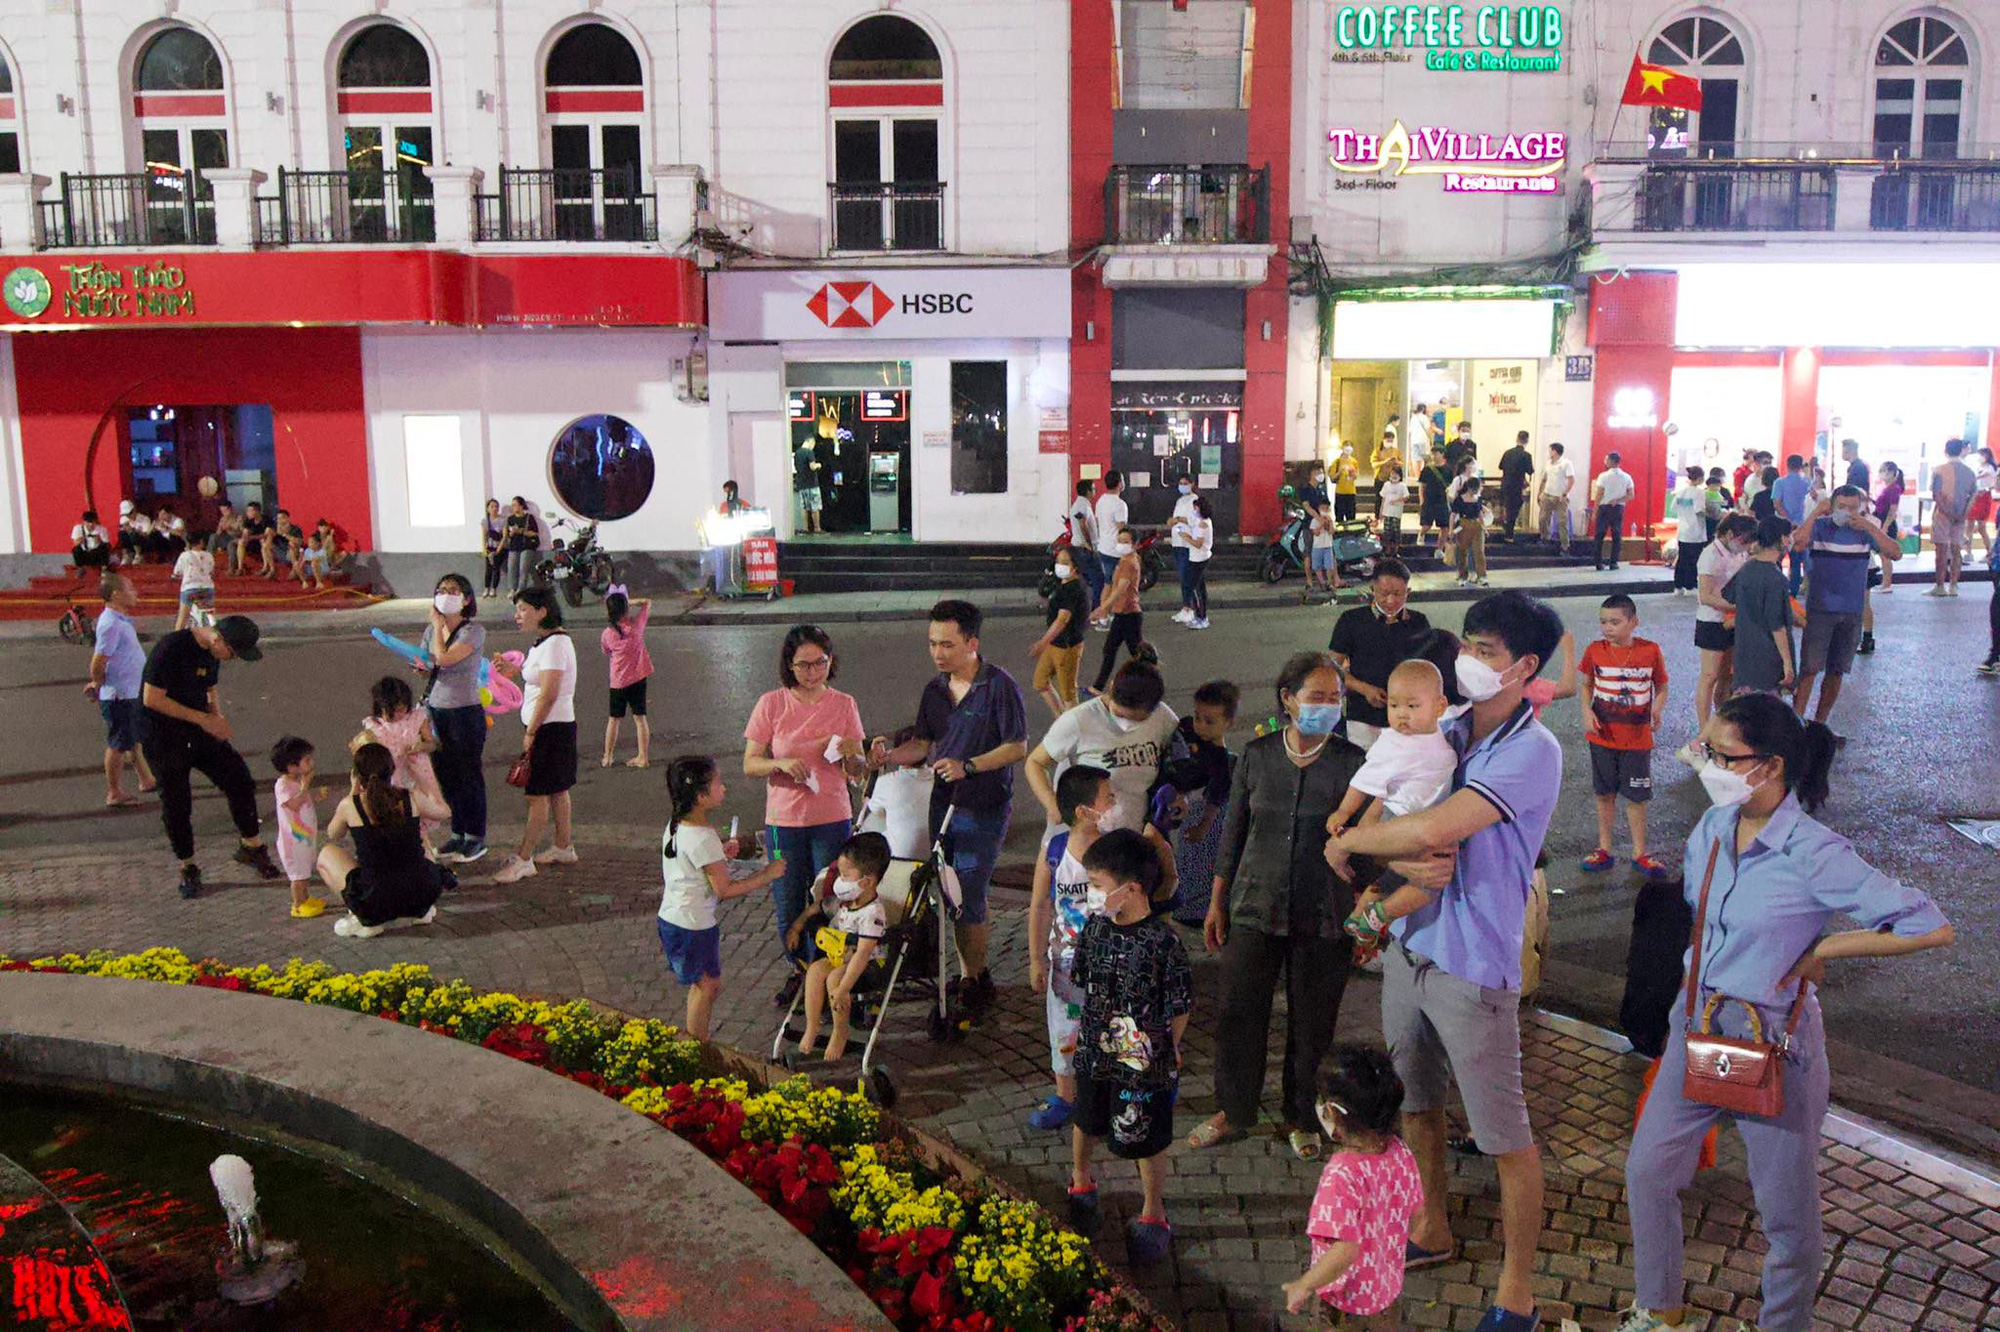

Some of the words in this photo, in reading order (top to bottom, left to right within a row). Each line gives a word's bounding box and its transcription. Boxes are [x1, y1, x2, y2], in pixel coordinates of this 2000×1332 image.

[1338, 6, 1464, 47] COFFEE
[1477, 6, 1562, 47] CLUB
[1426, 51, 1460, 70] Café
[1463, 54, 1477, 69] &
[1480, 51, 1561, 70] Restaurant
[136, 289, 195, 317] NAM
[901, 293, 973, 315] HSBC
[1566, 356, 1592, 374] 3B
